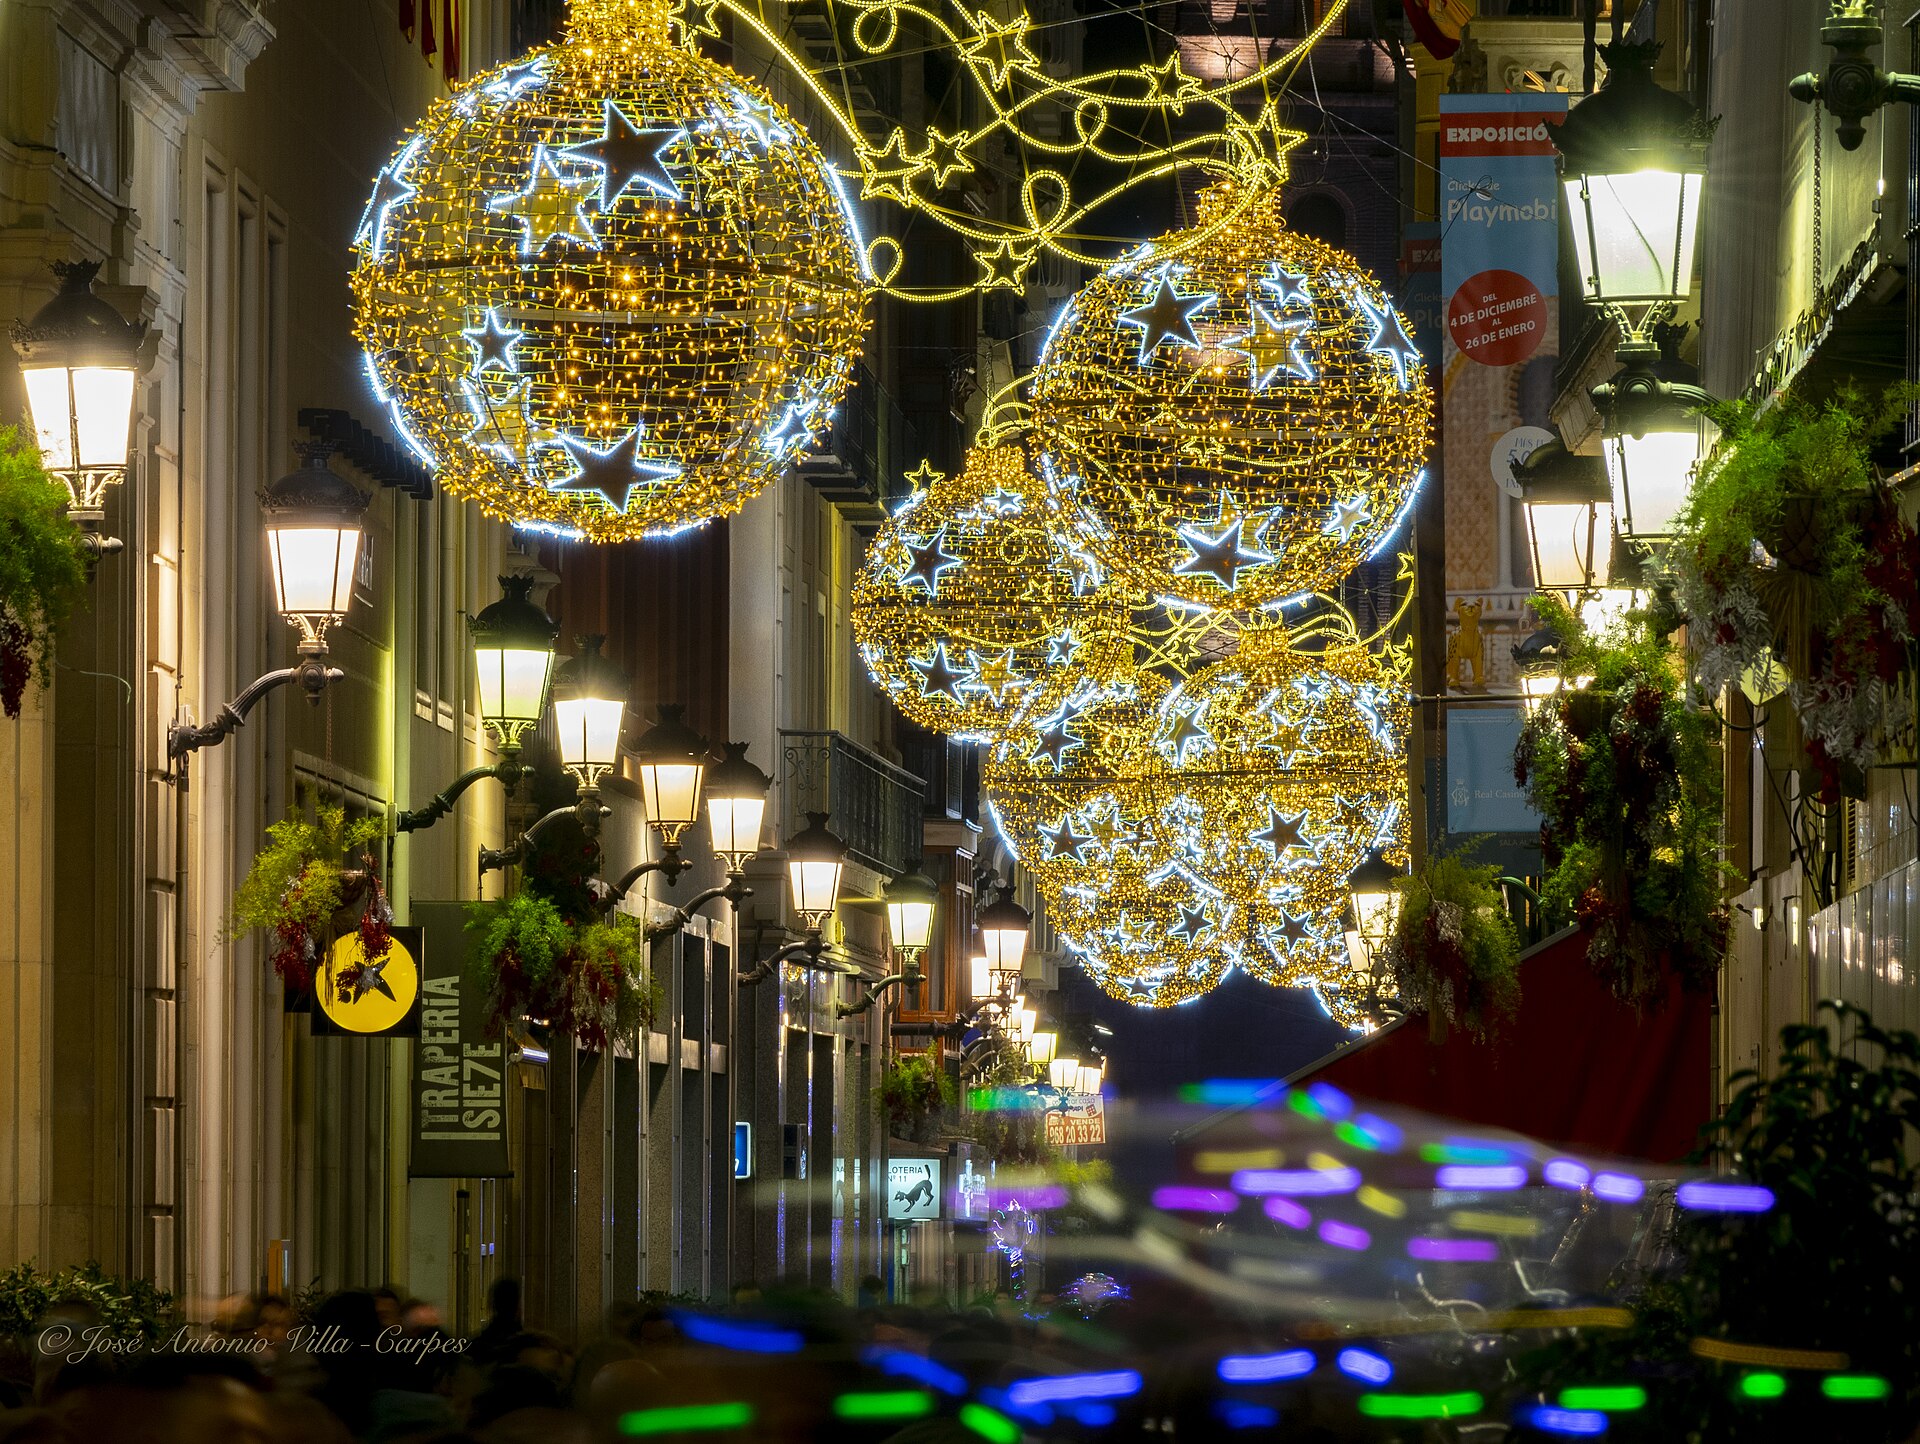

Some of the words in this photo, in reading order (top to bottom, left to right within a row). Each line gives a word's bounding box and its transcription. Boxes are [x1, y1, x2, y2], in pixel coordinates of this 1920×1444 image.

[1446, 123, 1552, 142] EXPOSICIÓ
[1447, 198, 1556, 227] Playmobi
[1483, 293, 1498, 303] DEL
[1450, 317, 1458, 327] 4
[1460, 312, 1475, 325] DE
[1477, 293, 1537, 320] DICIEMBRE
[1492, 318, 1502, 326] AL
[1465, 336, 1479, 350] 26
[1481, 331, 1497, 345] DE
[1499, 320, 1536, 340] ENERO
[1049, 1126, 1064, 1144] 968
[1066, 1125, 1076, 1144] 20
[1077, 1125, 1088, 1143] 33
[1090, 1124, 1101, 1142] 22
